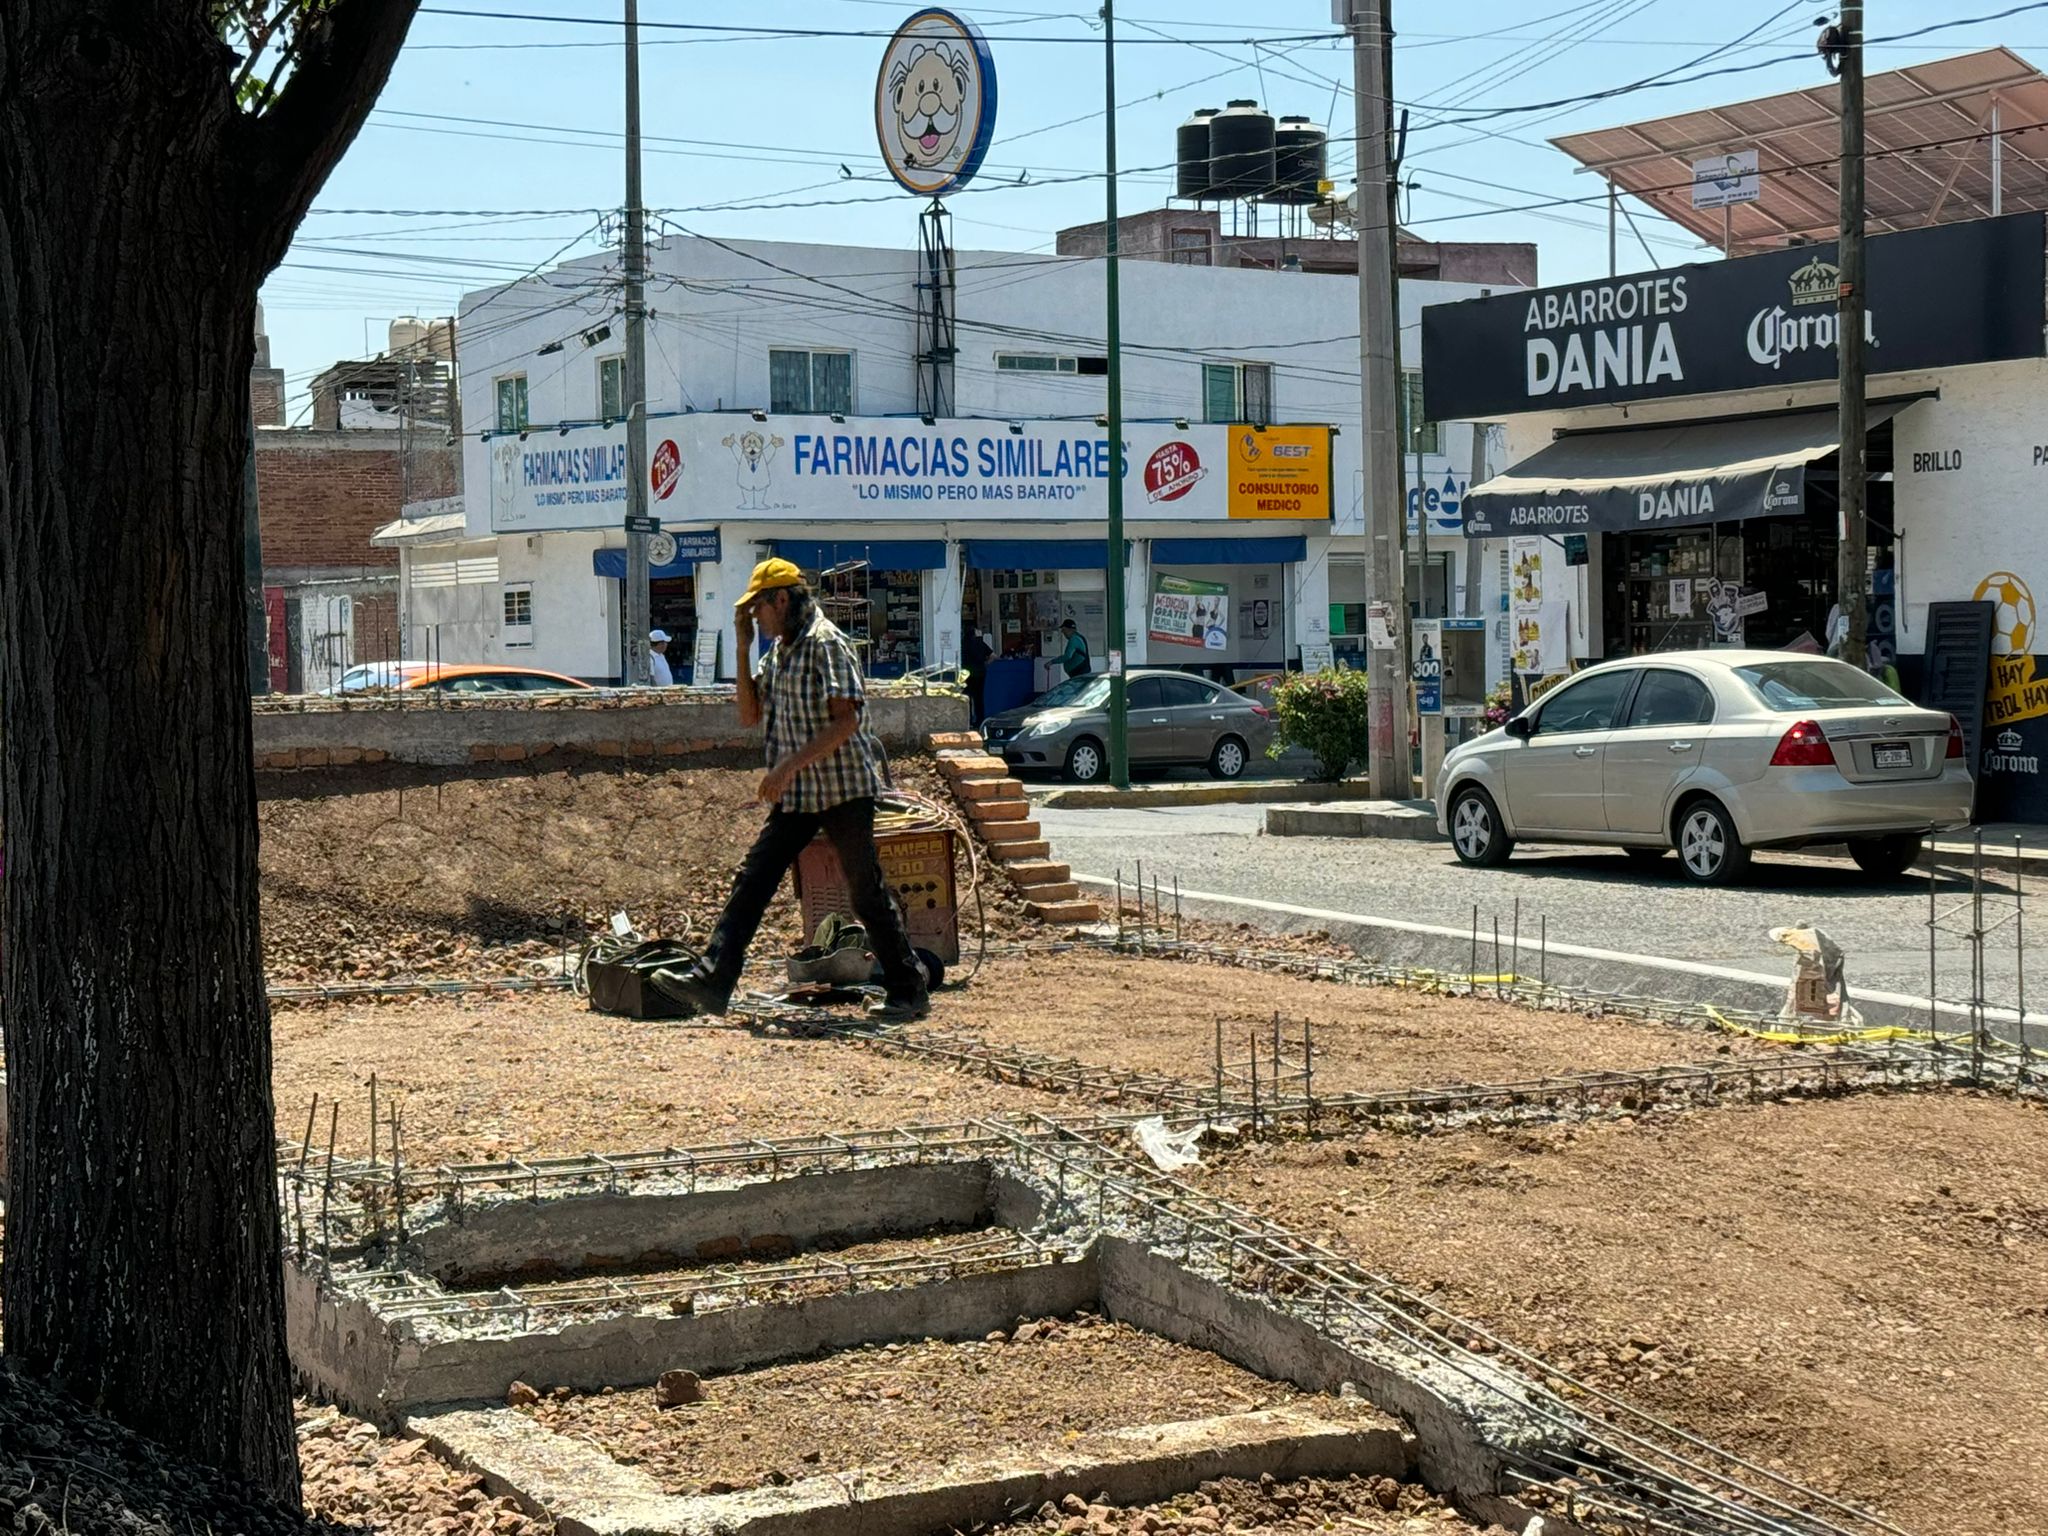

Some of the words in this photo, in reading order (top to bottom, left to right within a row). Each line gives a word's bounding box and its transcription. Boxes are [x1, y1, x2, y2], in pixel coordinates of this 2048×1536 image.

[1524, 275, 1688, 333] ABARROTES
[1747, 304, 1876, 369] Coro
[1526, 321, 1684, 397] DANIA
[794, 435, 969, 478] FARMACIAS
[1273, 445, 1313, 458] BEST
[1913, 449, 1962, 473] BRILLO
[523, 447, 580, 487] FARMACIAS
[583, 444, 628, 483] SIMILAR
[1152, 450, 1191, 486] 75%
[546, 491, 566, 506] MISMO
[567, 490, 585, 505] PERO
[585, 488, 600, 503] MAS
[884, 485, 933, 500] MISMO
[938, 485, 977, 500] PERO
[983, 485, 1013, 500] MAS
[1238, 482, 1320, 496] CONSULTORIO
[1257, 499, 1301, 511] MEDICO
[1638, 485, 1716, 522] DANIA
[1763, 493, 1799, 511] Corona
[1509, 505, 1590, 526] ABARROTES
[679, 536, 717, 546] FARMACIAS
[681, 547, 716, 558] SIMILARES
[1413, 661, 1439, 678] 300
[1996, 662, 2025, 688] HAY
[1981, 748, 2039, 777] Corona
